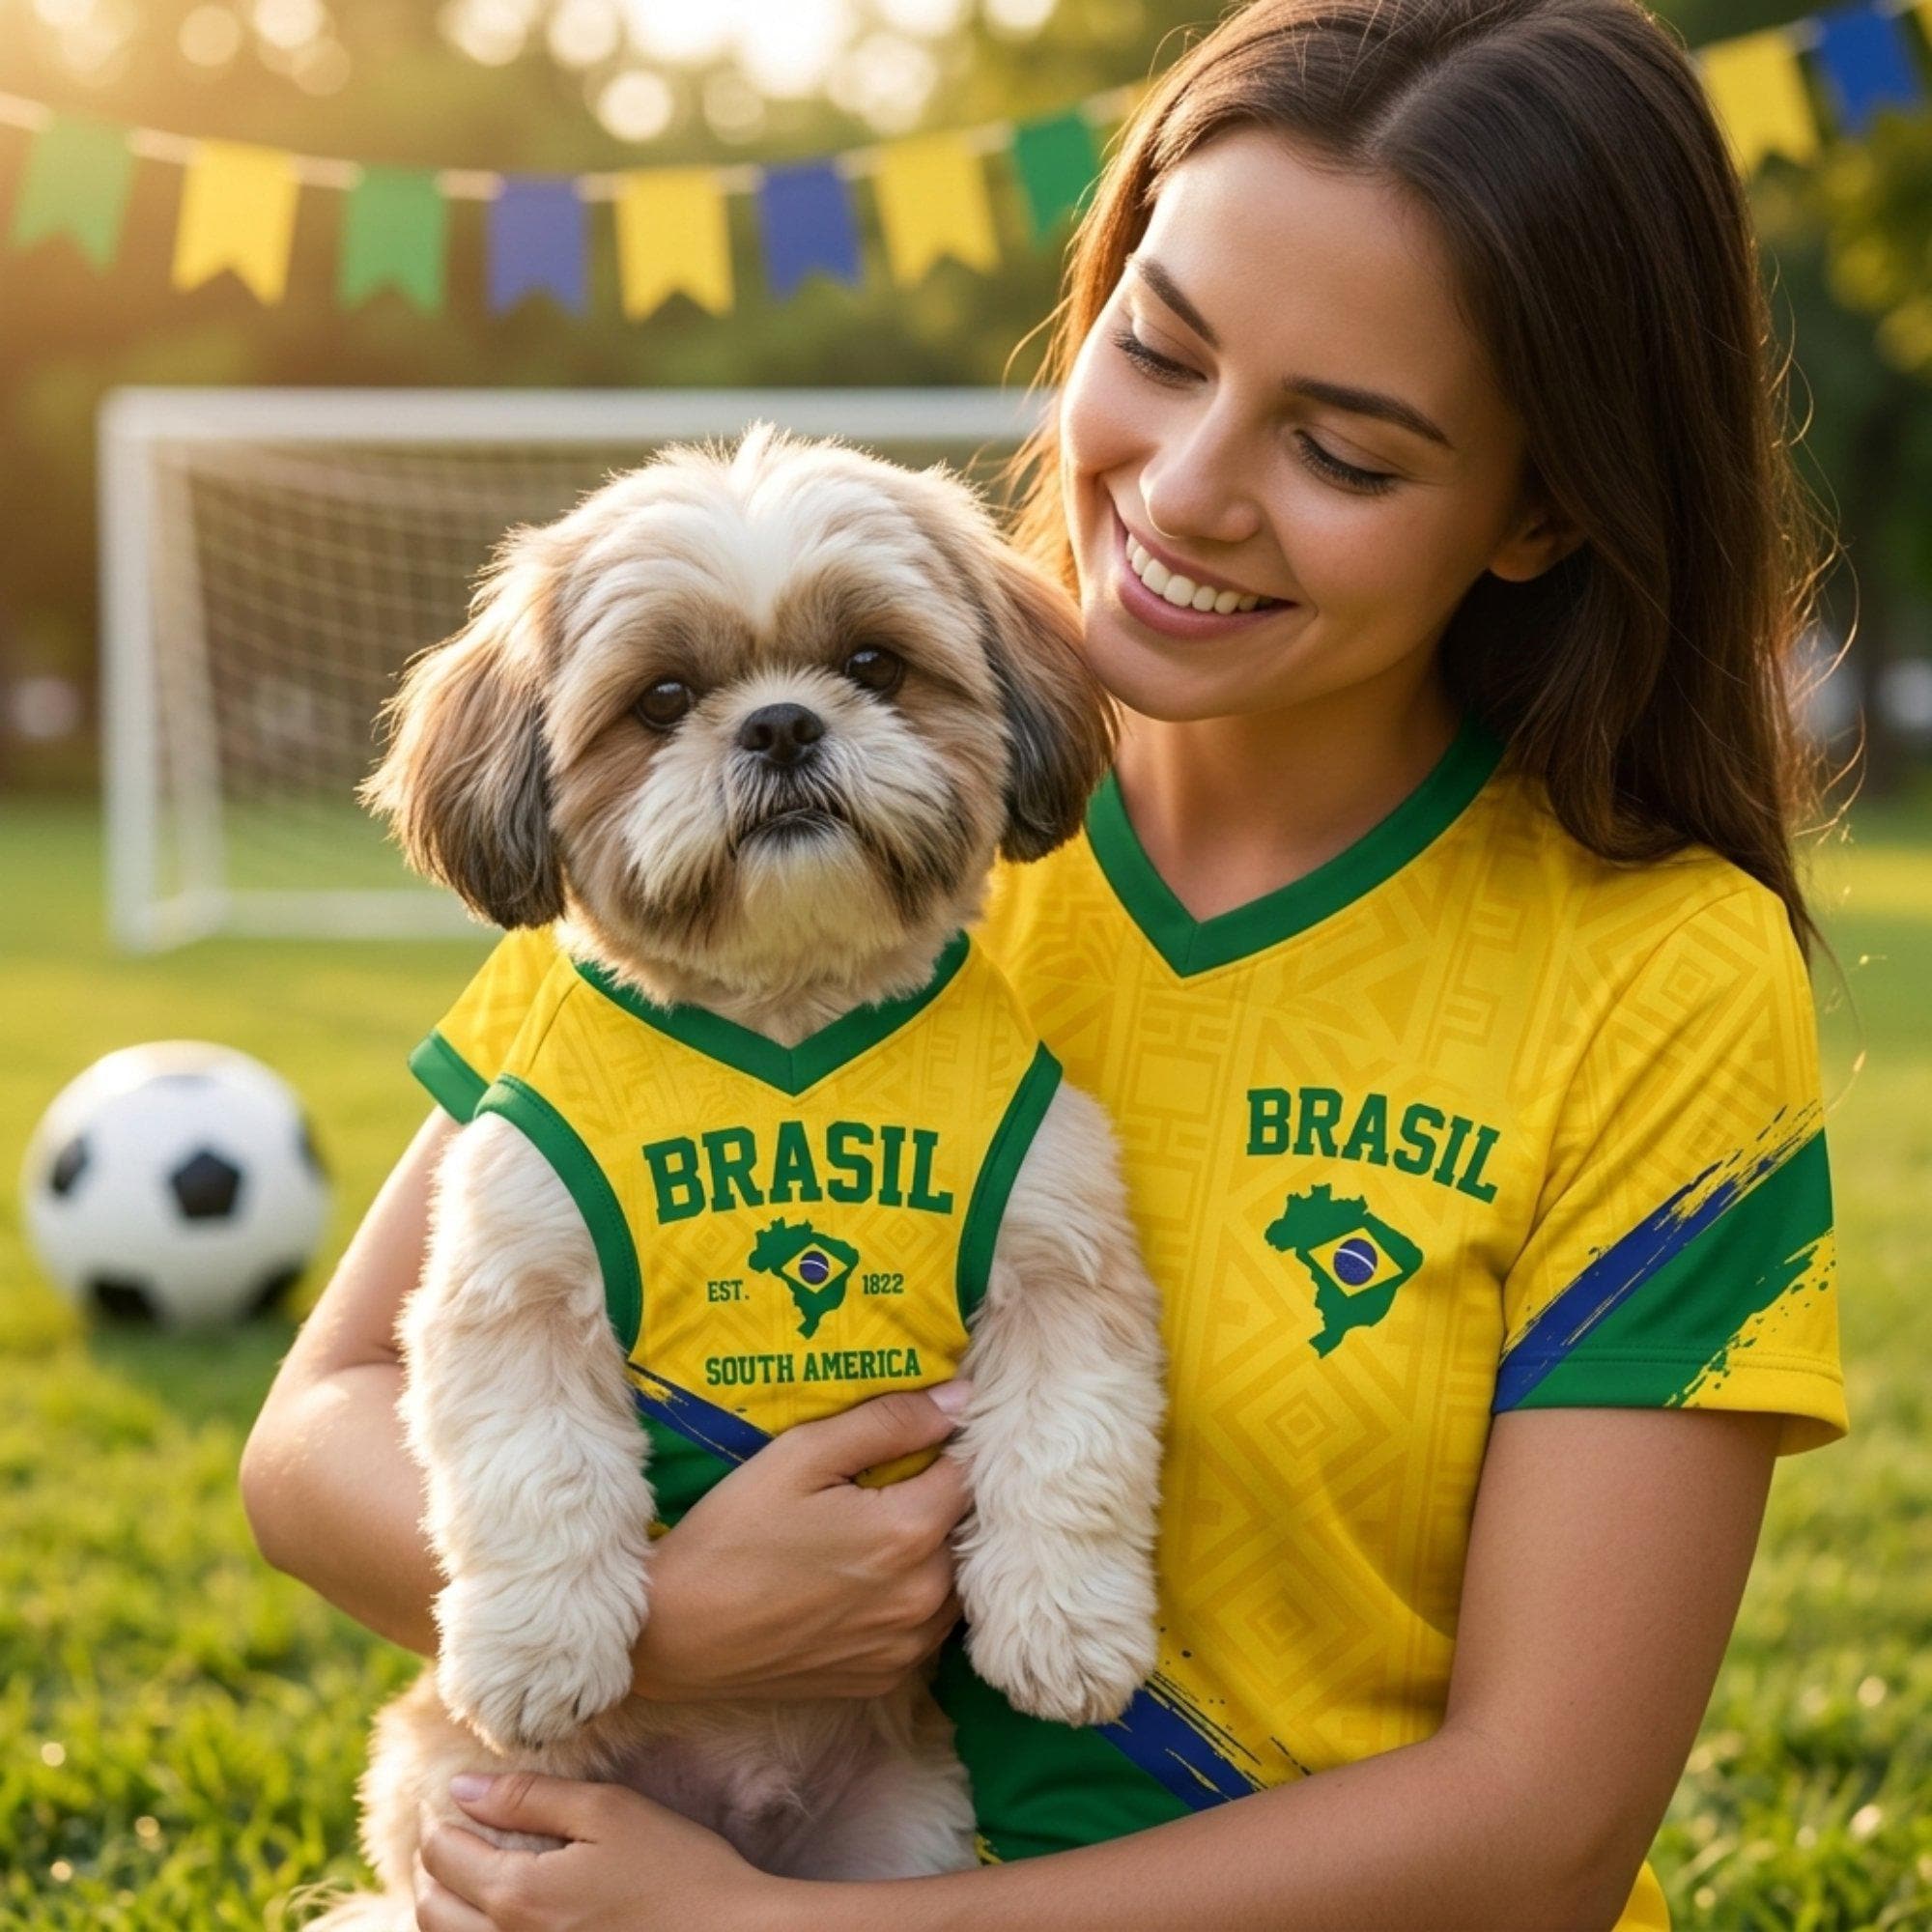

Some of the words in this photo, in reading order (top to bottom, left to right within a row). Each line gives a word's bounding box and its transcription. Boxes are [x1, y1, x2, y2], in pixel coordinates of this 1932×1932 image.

[642, 1121, 953, 1225] BRASIL
[1246, 1087, 1501, 1205] BRASIL
[707, 1279, 750, 1302] EST.
[862, 1272, 904, 1295] 1822
[704, 1352, 795, 1385] SOUTH
[802, 1348, 923, 1381] AMERICA
